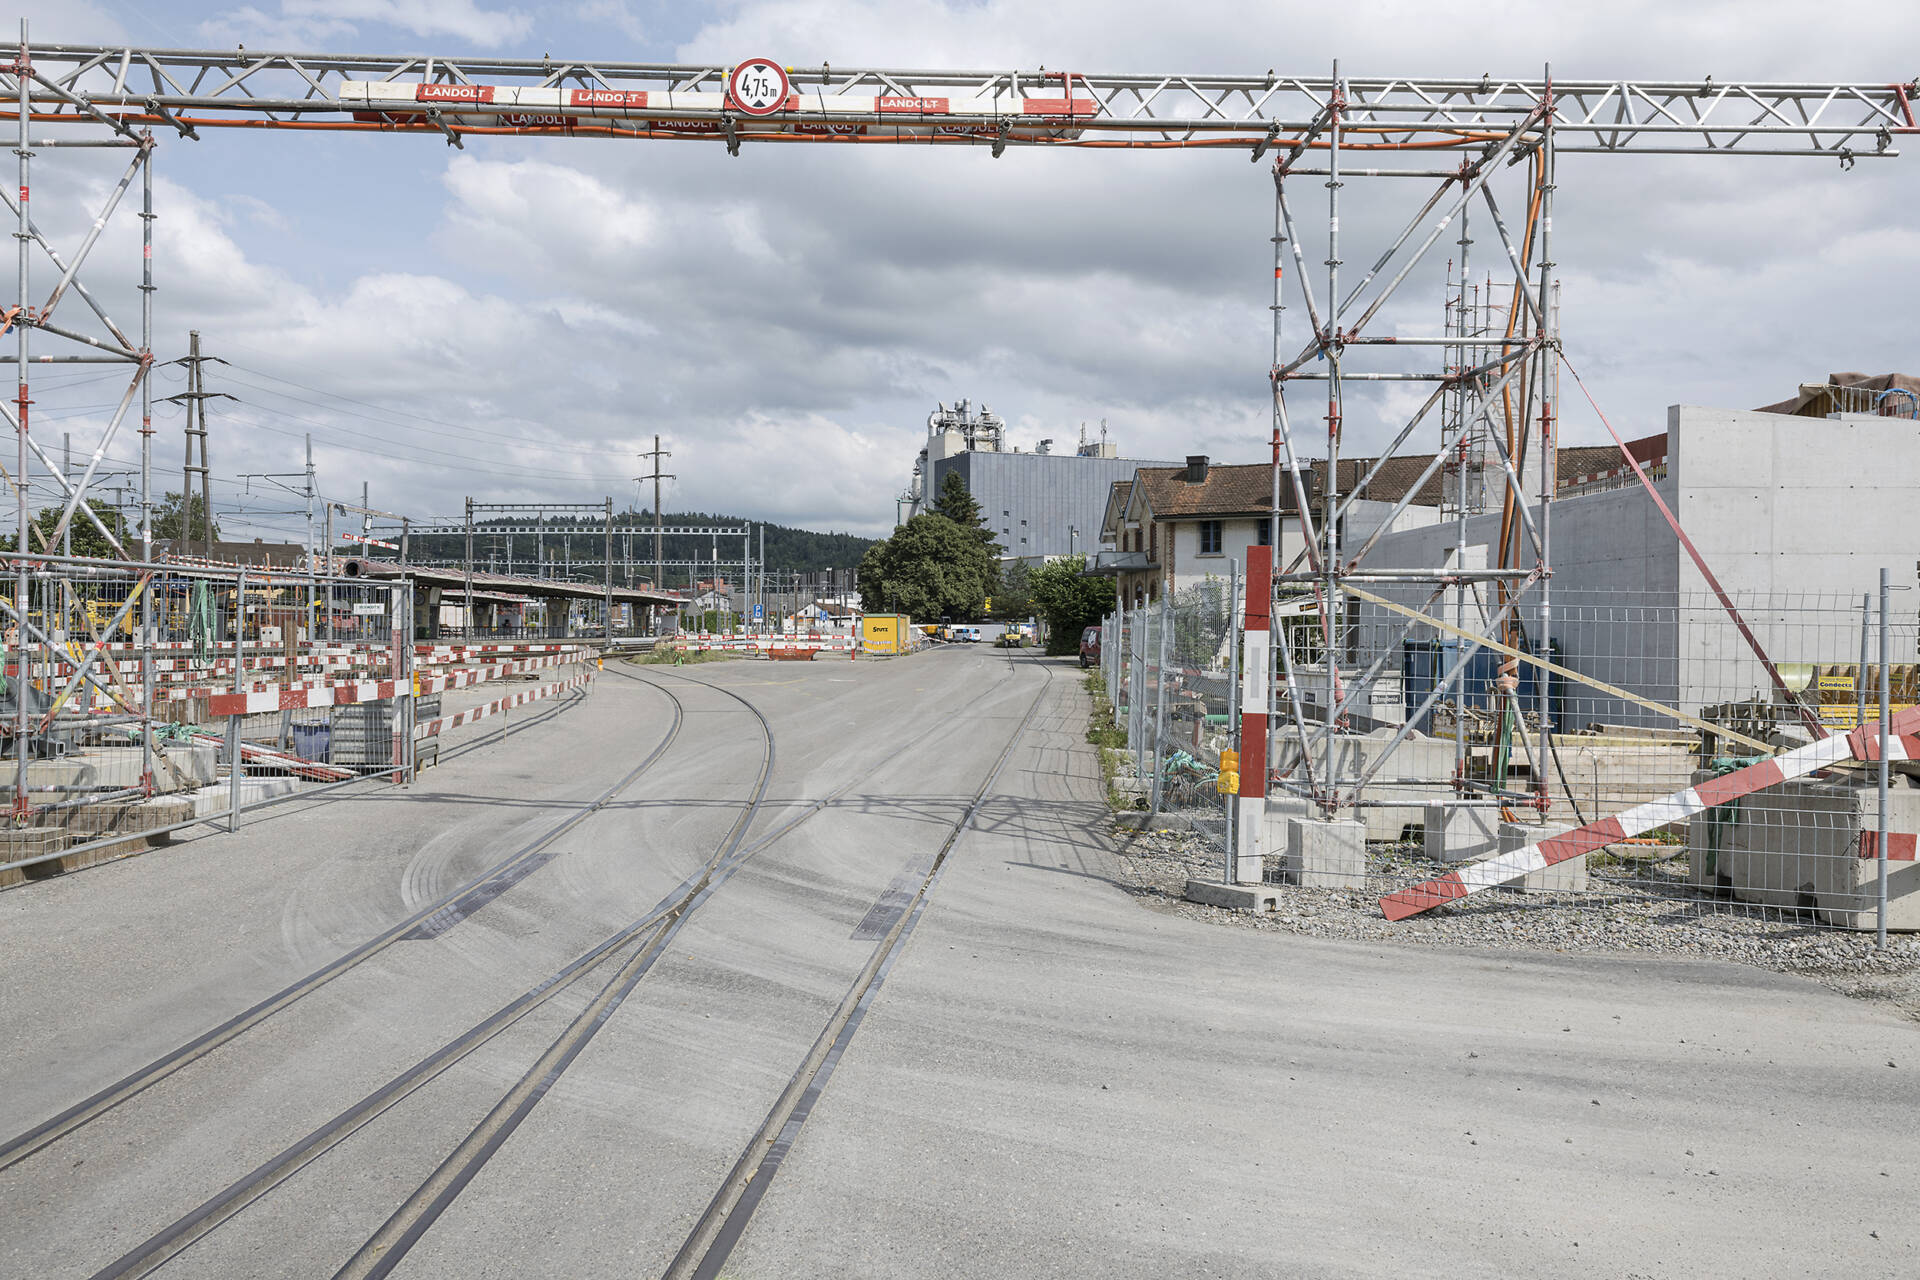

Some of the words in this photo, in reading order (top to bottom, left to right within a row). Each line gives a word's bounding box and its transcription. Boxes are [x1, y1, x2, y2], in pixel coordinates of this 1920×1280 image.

[741, 73, 768, 99] 4,75
[769, 88, 777, 98] m
[424, 87, 485, 98] LANDOLT
[578, 92, 639, 103] LANDOLT
[880, 99, 939, 109] LANDOLT
